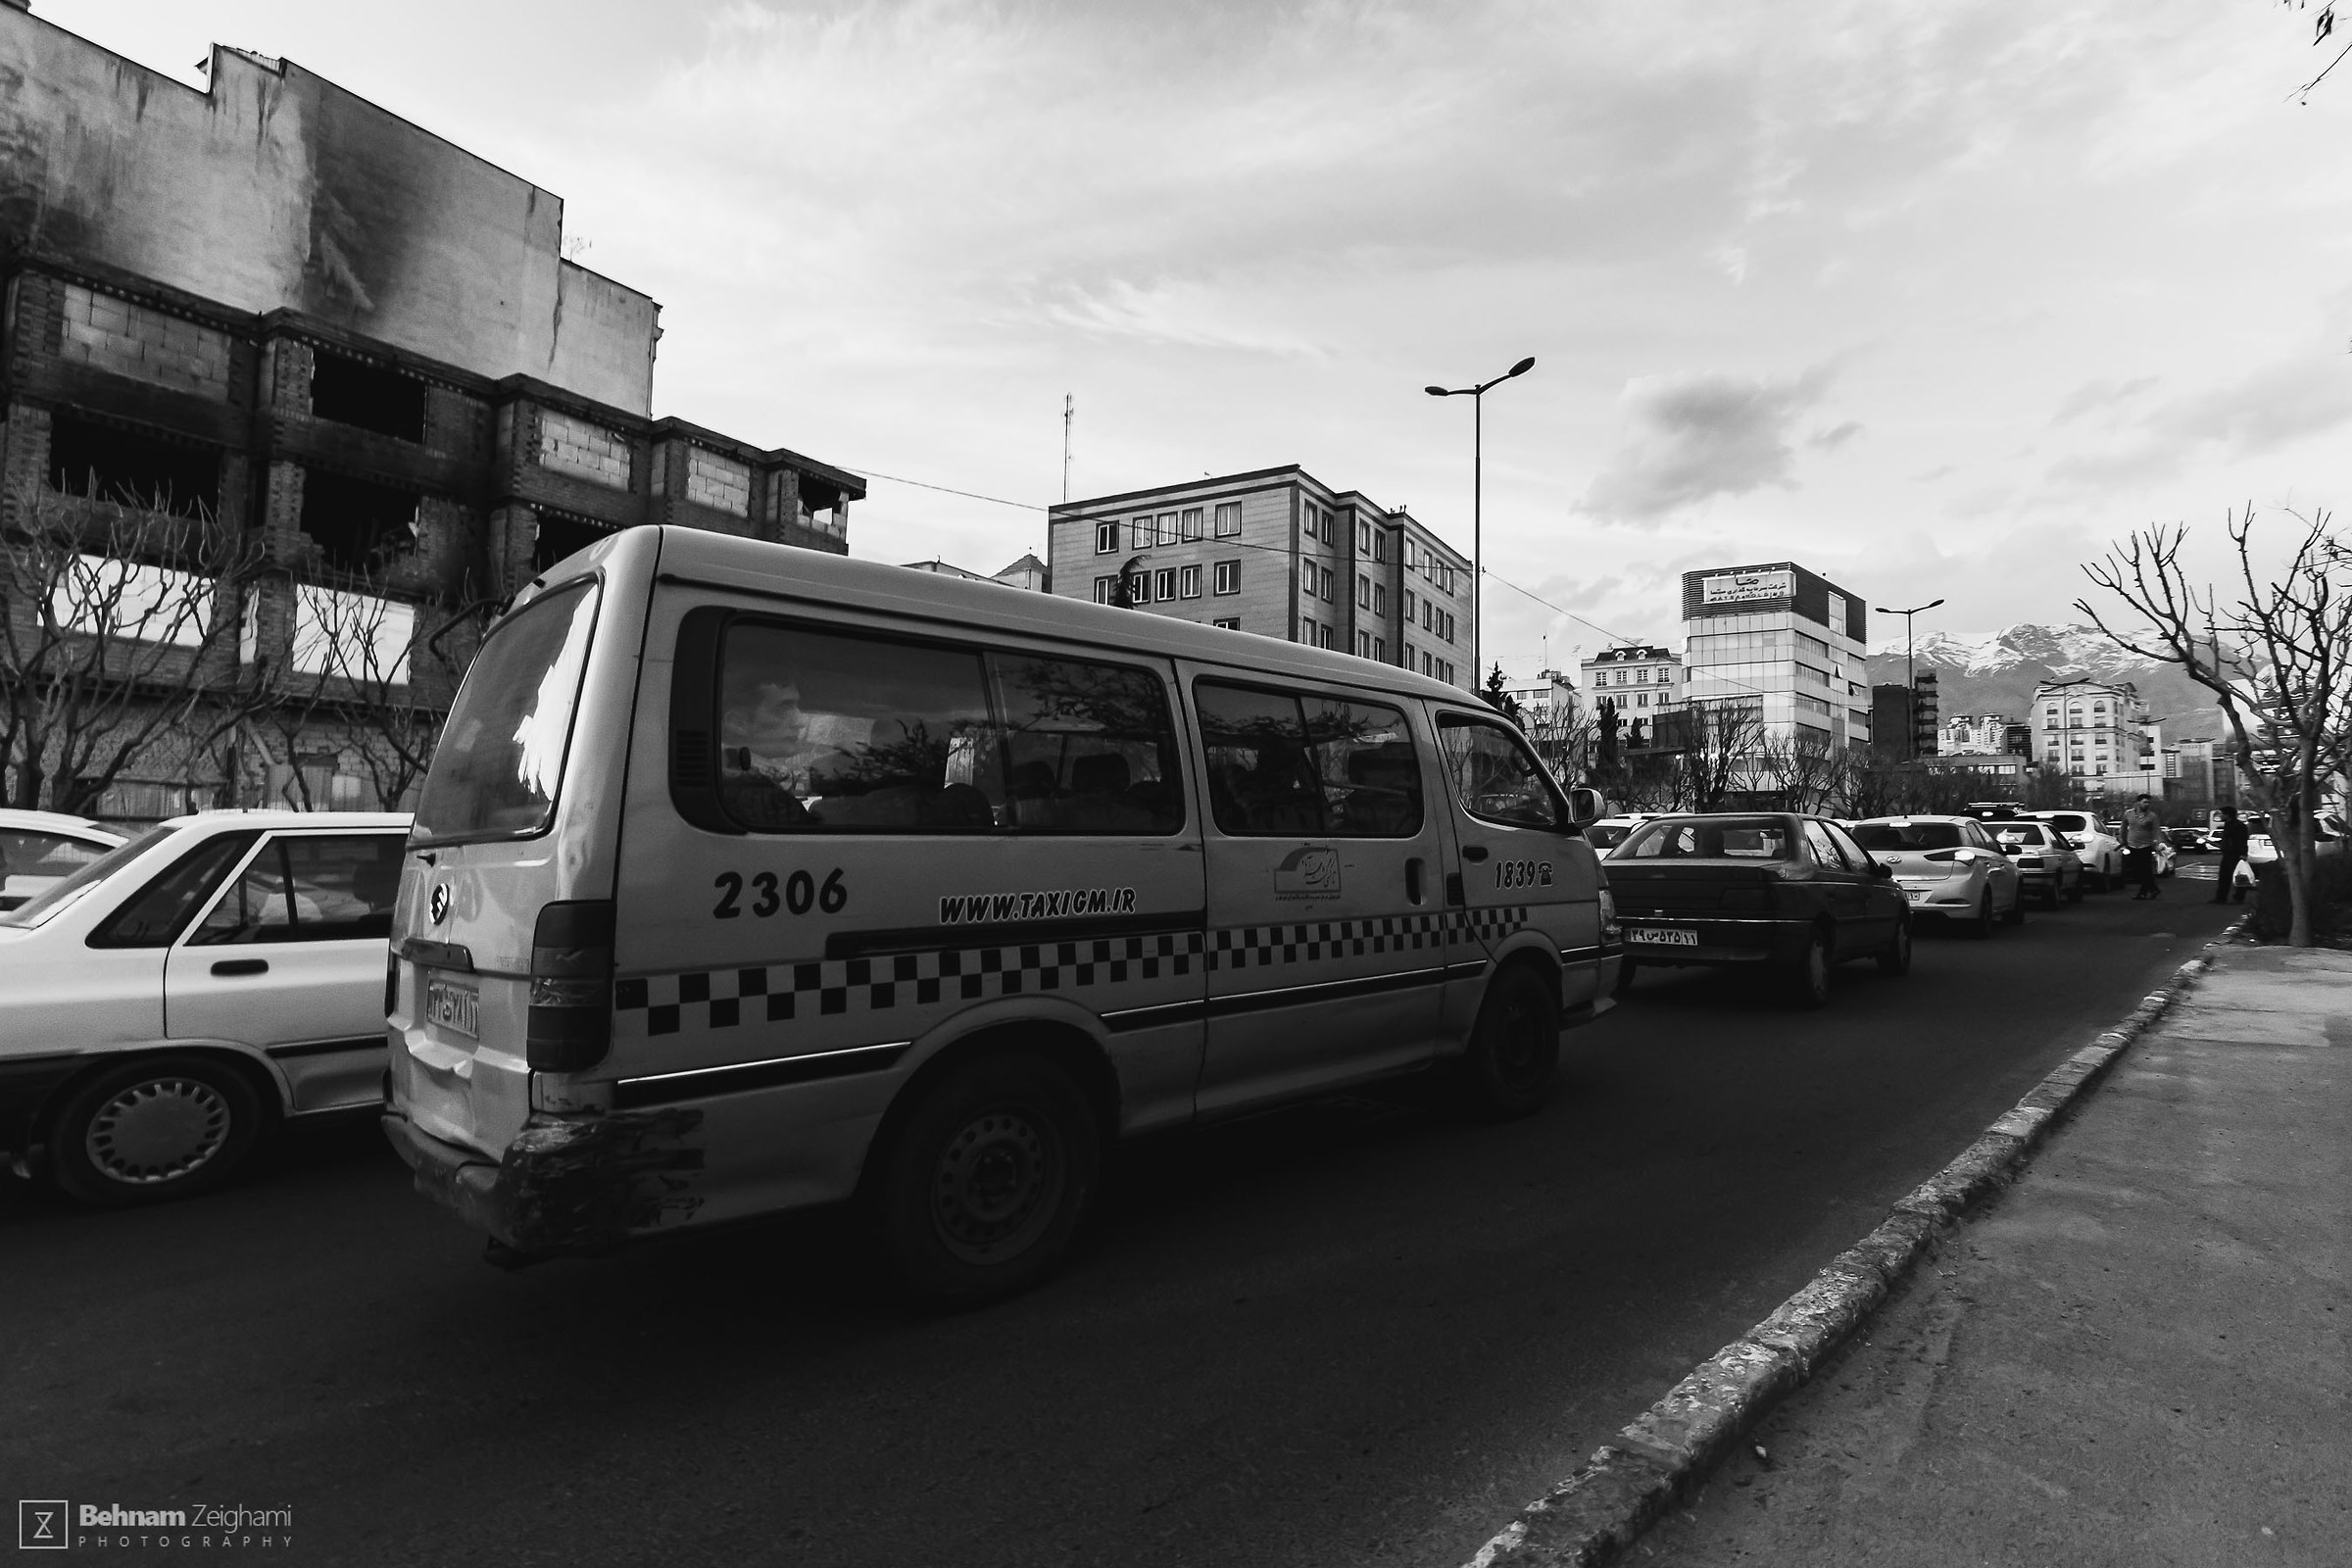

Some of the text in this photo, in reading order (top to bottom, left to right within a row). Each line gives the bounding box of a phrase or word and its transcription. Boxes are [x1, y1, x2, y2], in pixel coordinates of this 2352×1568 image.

[712, 867, 849, 918] 2306
[1494, 859, 1536, 891] 1839
[938, 887, 1137, 925] WWW.TAXIGM.IR
